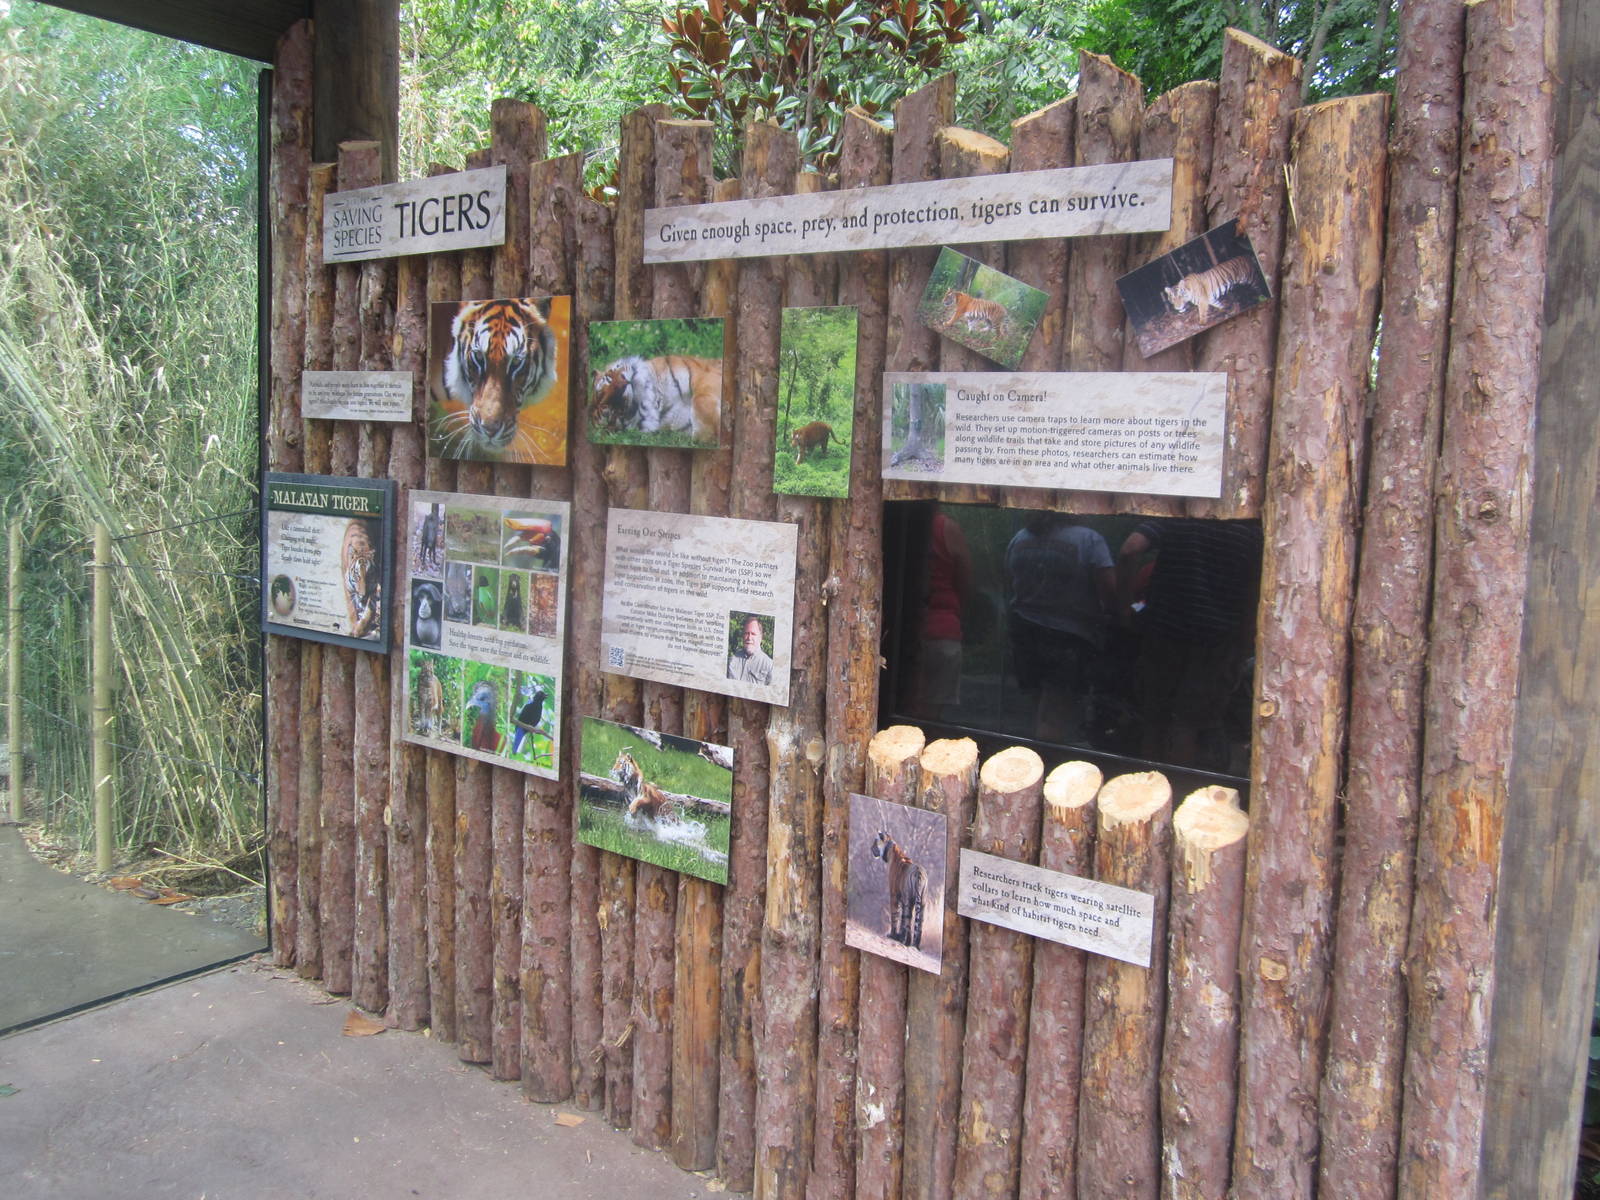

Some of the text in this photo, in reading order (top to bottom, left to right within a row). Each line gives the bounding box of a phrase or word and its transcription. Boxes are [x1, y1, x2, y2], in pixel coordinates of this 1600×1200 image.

[333, 205, 382, 228] SAVING
[394, 190, 491, 238] TIGERS
[660, 186, 1145, 243] Given enough space, prey, and protection, tigers can survive.
[333, 226, 382, 248] SPECIES
[957, 390, 990, 404] Caught
[1007, 390, 1047, 403] Camera!
[956, 413, 999, 422] Researchers
[1048, 415, 1067, 425] traps
[1070, 416, 1078, 424] to
[1080, 416, 1100, 424] learn
[1127, 417, 1152, 425] about
[1155, 418, 1178, 428] tigers
[1192, 418, 1207, 426] the
[975, 424, 992, 434] They
[994, 425, 1005, 433] set
[1008, 427, 1018, 435] up
[1020, 425, 1086, 437] motion-triggered
[1138, 429, 1160, 439] posts
[1175, 430, 1197, 438] trees
[955, 434, 1200, 451] along wildlife trails that take and store pictures of any wildlife
[955, 444, 982, 455] passing
[984, 445, 995, 456] by.
[997, 446, 1016, 455] From
[1018, 447, 1039, 456] these
[1073, 450, 1119, 459] researchers
[1139, 452, 1176, 461] estimate
[1178, 453, 1198, 462] how
[954, 457, 974, 465] many
[976, 455, 997, 466] tigers
[1012, 457, 1020, 465] in
[1053, 459, 1068, 468] and
[1071, 460, 1091, 469] what
[1093, 462, 1115, 470] other
[1117, 463, 1150, 472] animals
[1152, 464, 1167, 472] live
[273, 490, 369, 512] MALAYAN TIGER
[755, 562, 778, 570] partners
[709, 575, 740, 585] maintaining
[747, 579, 767, 588] healthy
[751, 589, 773, 597] research
[973, 866, 1141, 918] Researchers track tigers wearing satellite
[972, 882, 1120, 927] collars to learn how much space and
[972, 895, 1101, 937] what kind of habitat tigers need.
